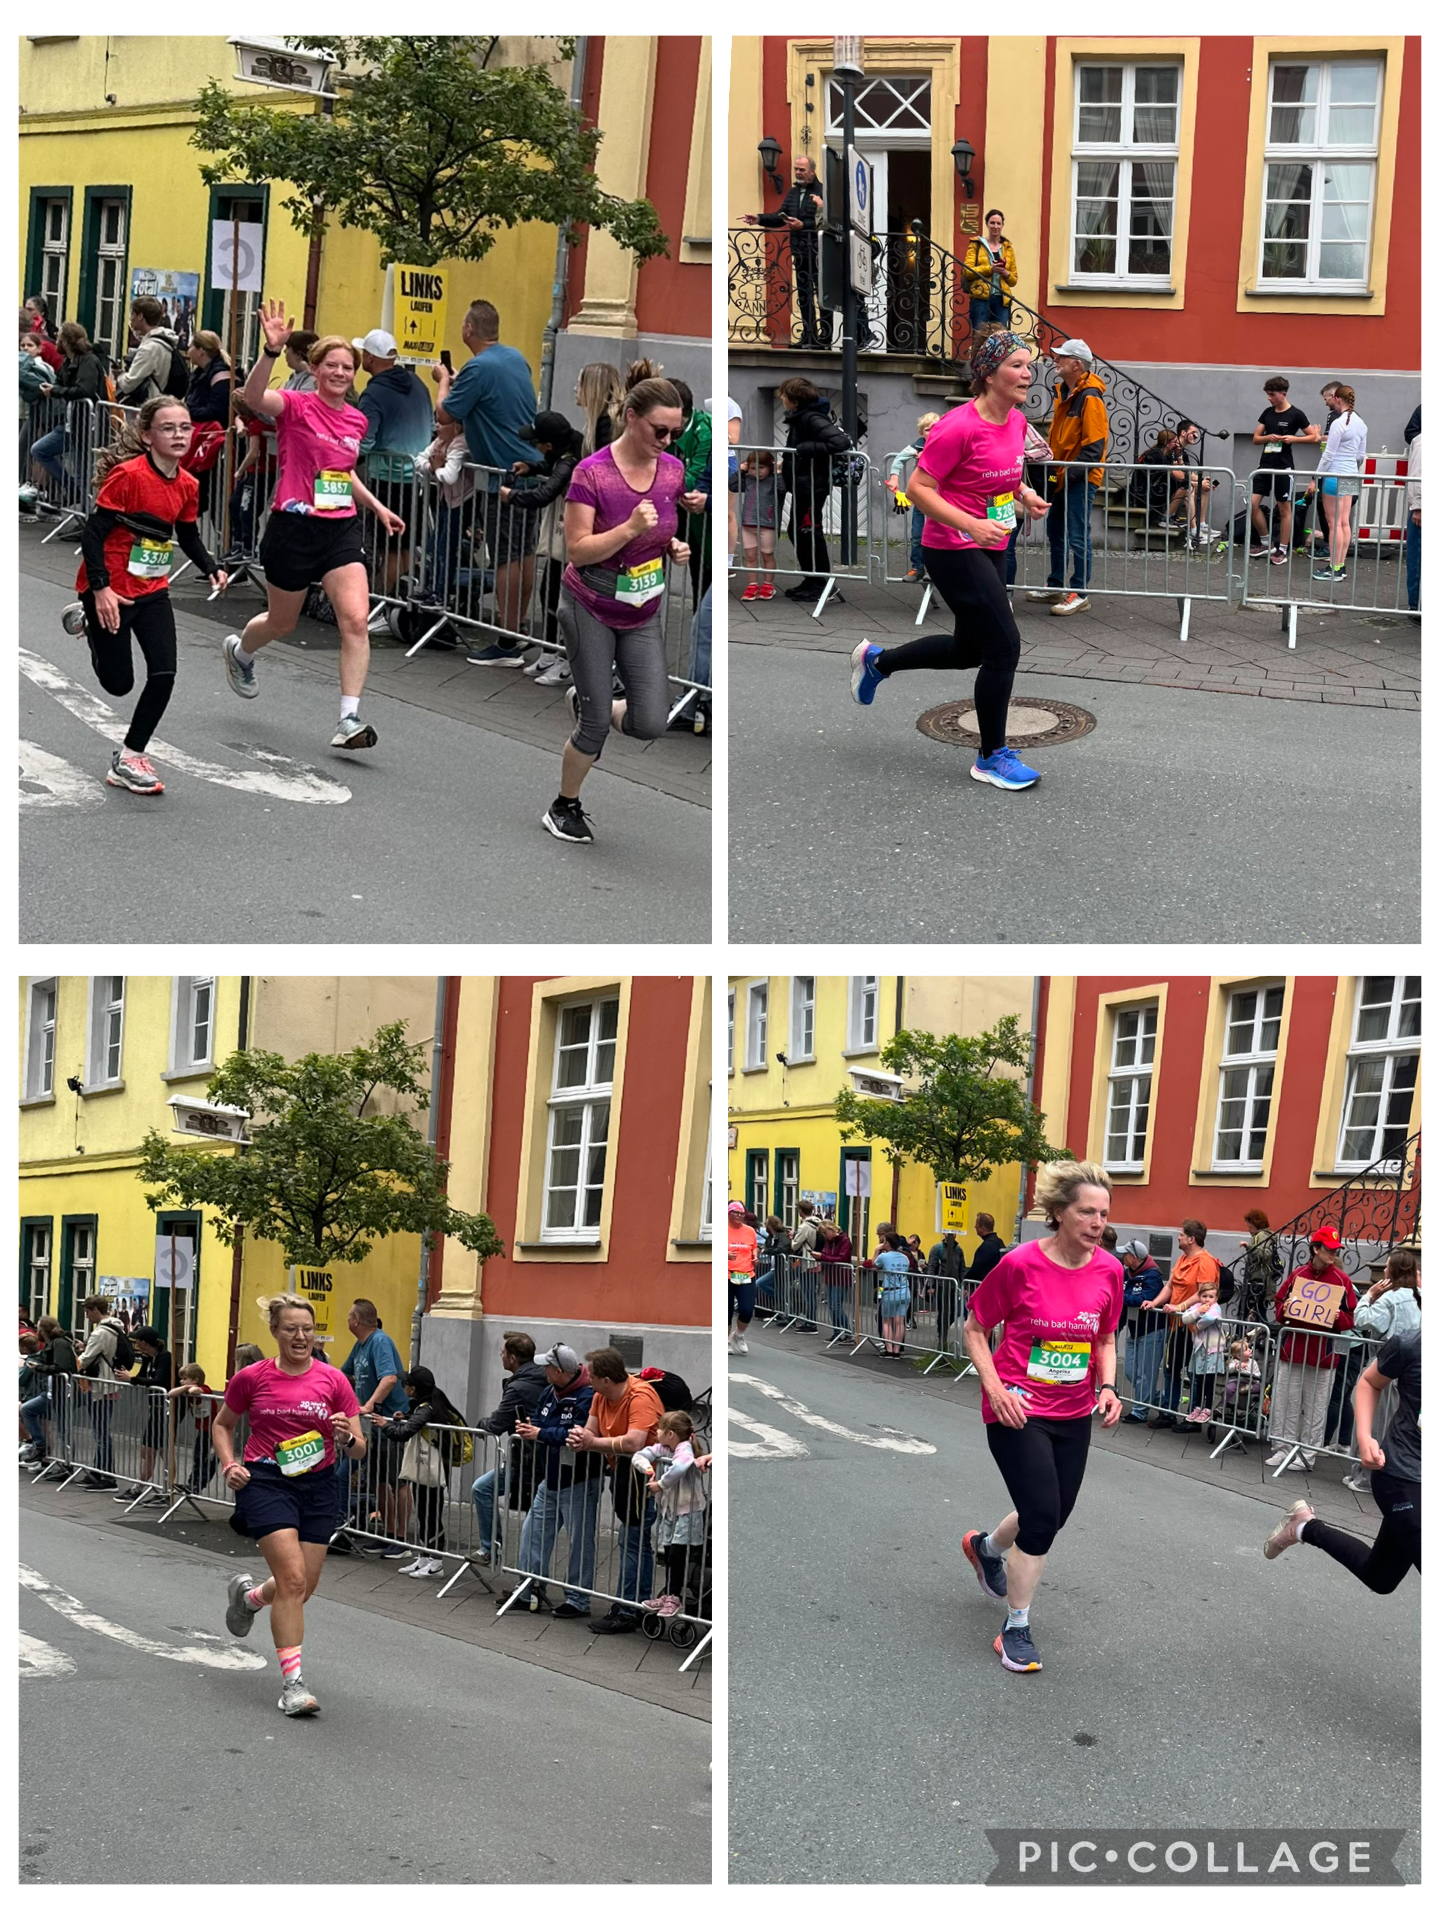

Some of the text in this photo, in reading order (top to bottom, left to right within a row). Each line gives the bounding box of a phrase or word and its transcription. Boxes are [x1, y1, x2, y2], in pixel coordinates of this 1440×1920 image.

[133, 280, 158, 295] Total
[400, 270, 443, 301] LINKS
[410, 300, 433, 313] LAUFEN
[982, 470, 998, 478] reha
[1000, 467, 1011, 477] bad
[322, 481, 348, 494] 3857
[140, 550, 170, 564] 3318
[629, 572, 657, 591] 3139
[945, 1185, 967, 1201] LINKS
[300, 1270, 333, 1292] LINKS
[1301, 1281, 1331, 1302] GO
[1288, 1299, 1333, 1326] GIRL
[1030, 1318, 1092, 1331] reha bad hamm
[1039, 1350, 1082, 1367] 3004
[300, 1400, 310, 1409] 20
[260, 1408, 275, 1416] reha
[292, 1408, 315, 1417] hamm
[285, 1441, 318, 1461] 3001
